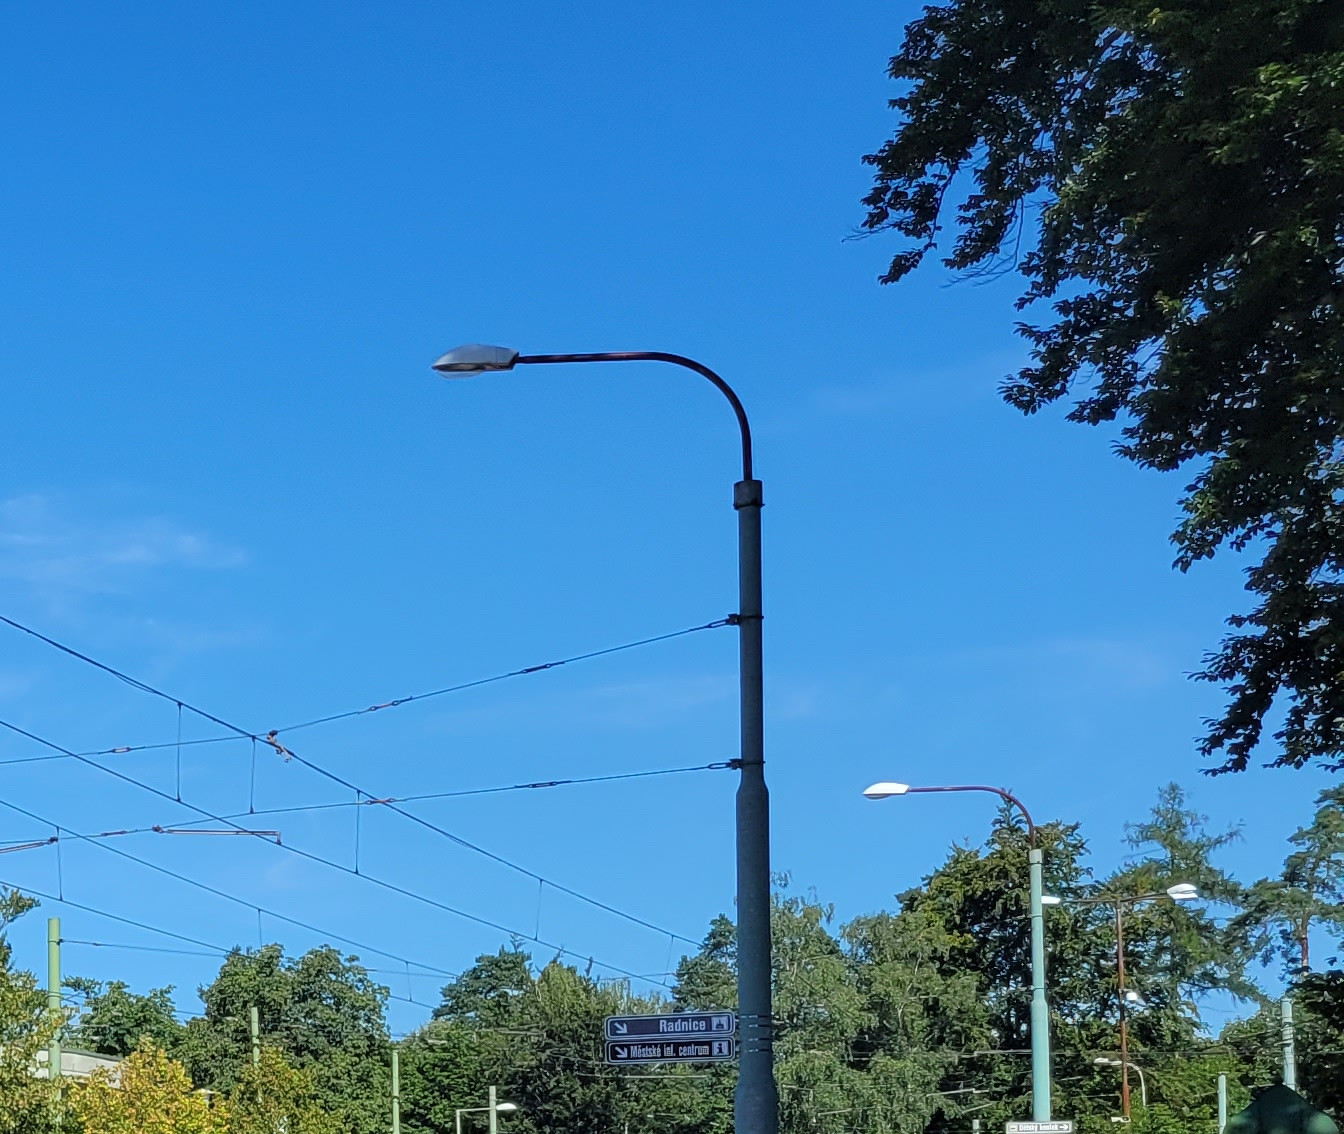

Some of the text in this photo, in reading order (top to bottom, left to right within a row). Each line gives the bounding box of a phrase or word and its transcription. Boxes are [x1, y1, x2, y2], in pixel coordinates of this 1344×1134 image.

[659, 1019, 706, 1033] Radnice
[630, 1045, 661, 1058] Městské
[678, 1045, 710, 1057] centrum
